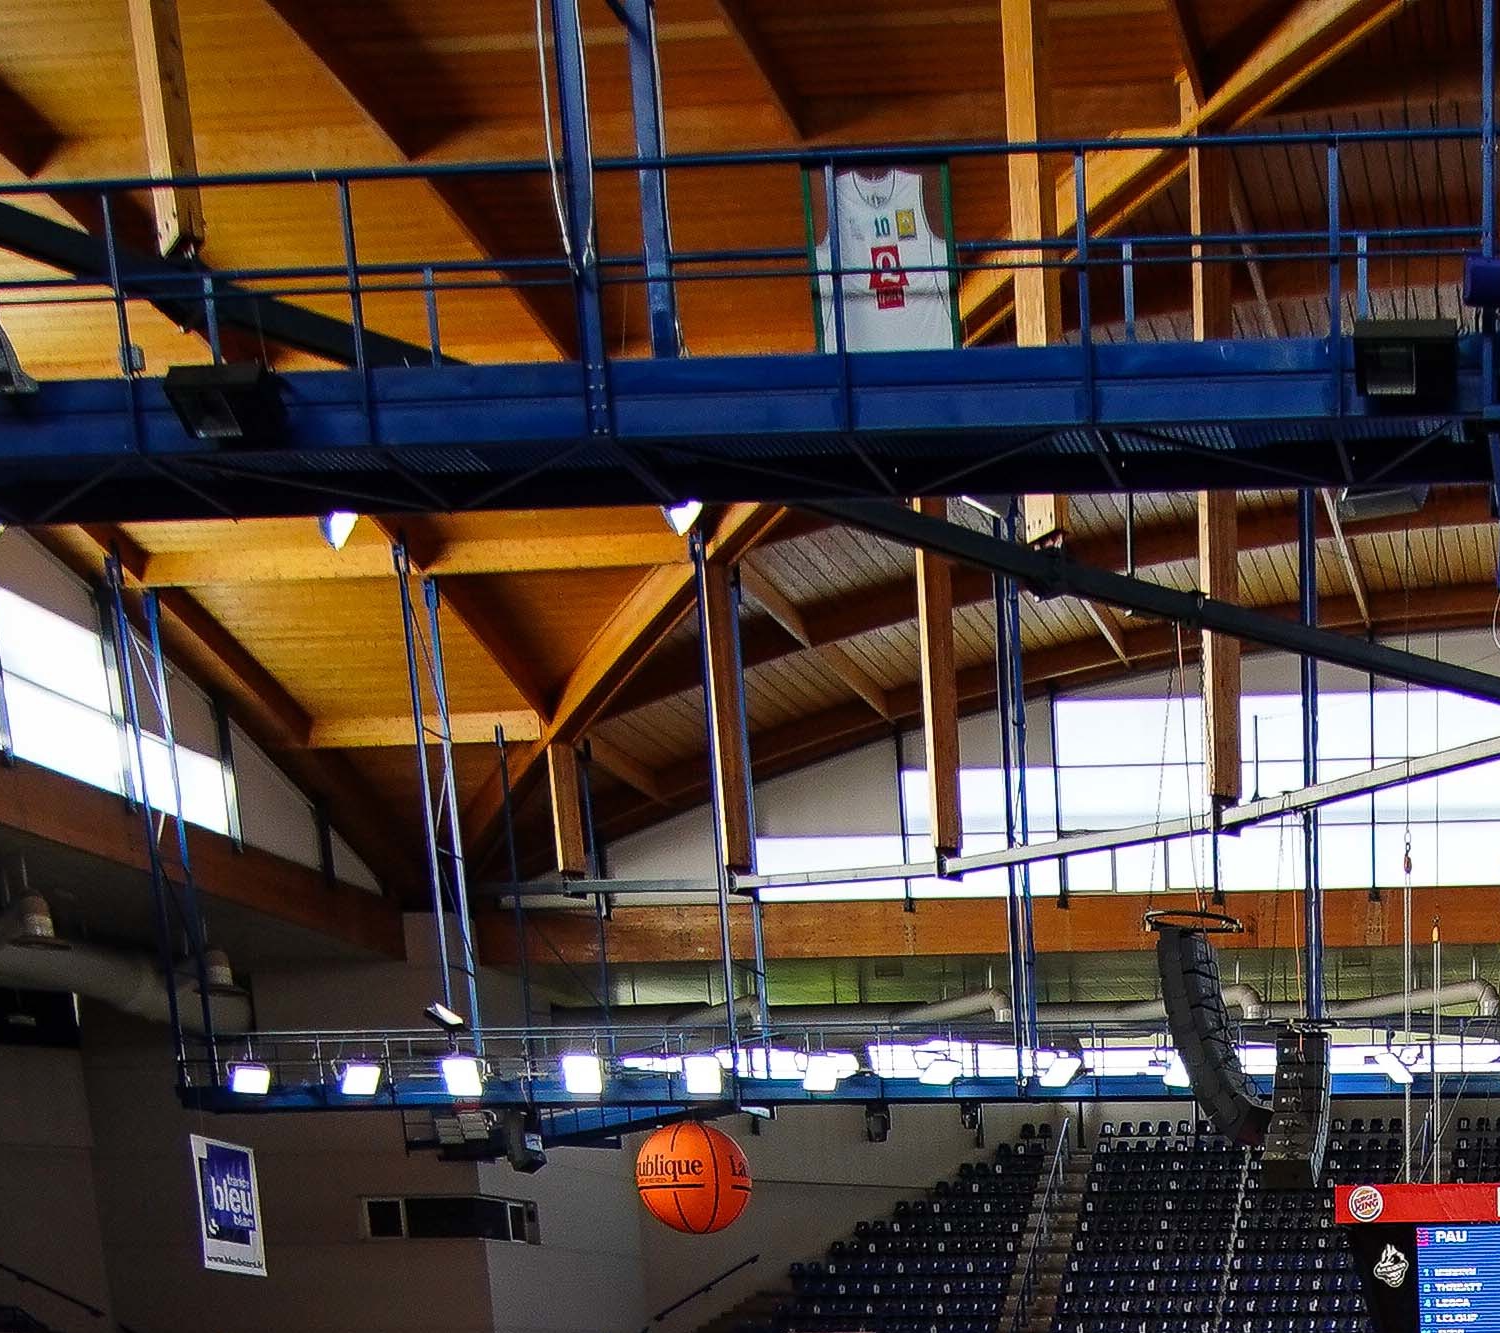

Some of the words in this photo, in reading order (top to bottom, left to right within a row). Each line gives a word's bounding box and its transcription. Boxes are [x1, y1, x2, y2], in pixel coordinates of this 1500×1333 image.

[210, 1174, 253, 1216] bleu
[1356, 1200, 1379, 1213] KING
[1435, 1230, 1468, 1243] PAU
